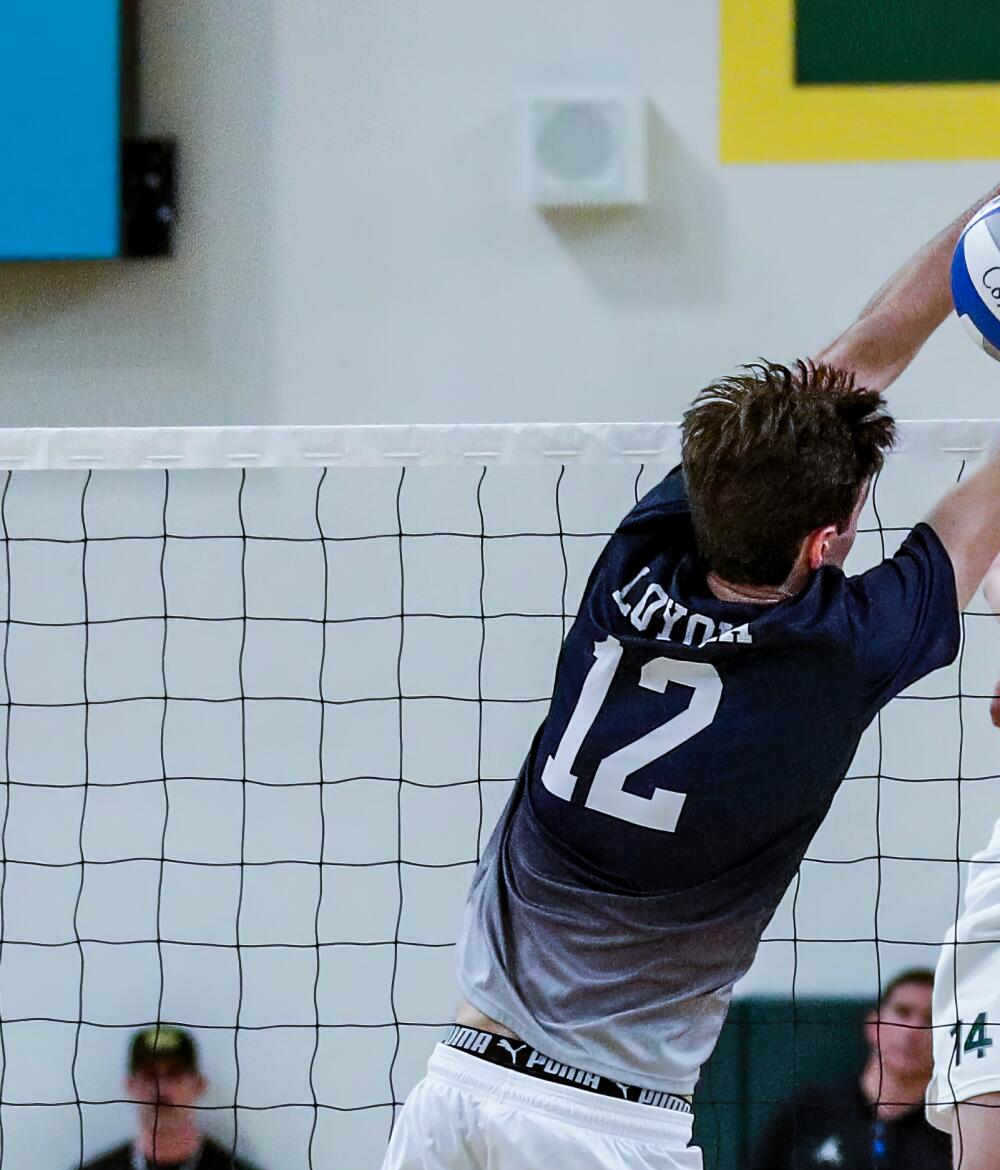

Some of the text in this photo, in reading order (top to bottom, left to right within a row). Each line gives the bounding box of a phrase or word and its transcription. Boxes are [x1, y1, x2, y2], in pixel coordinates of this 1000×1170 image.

[541, 634, 724, 833] 12
[442, 1025, 493, 1054] UMA
[949, 1011, 993, 1066] 14
